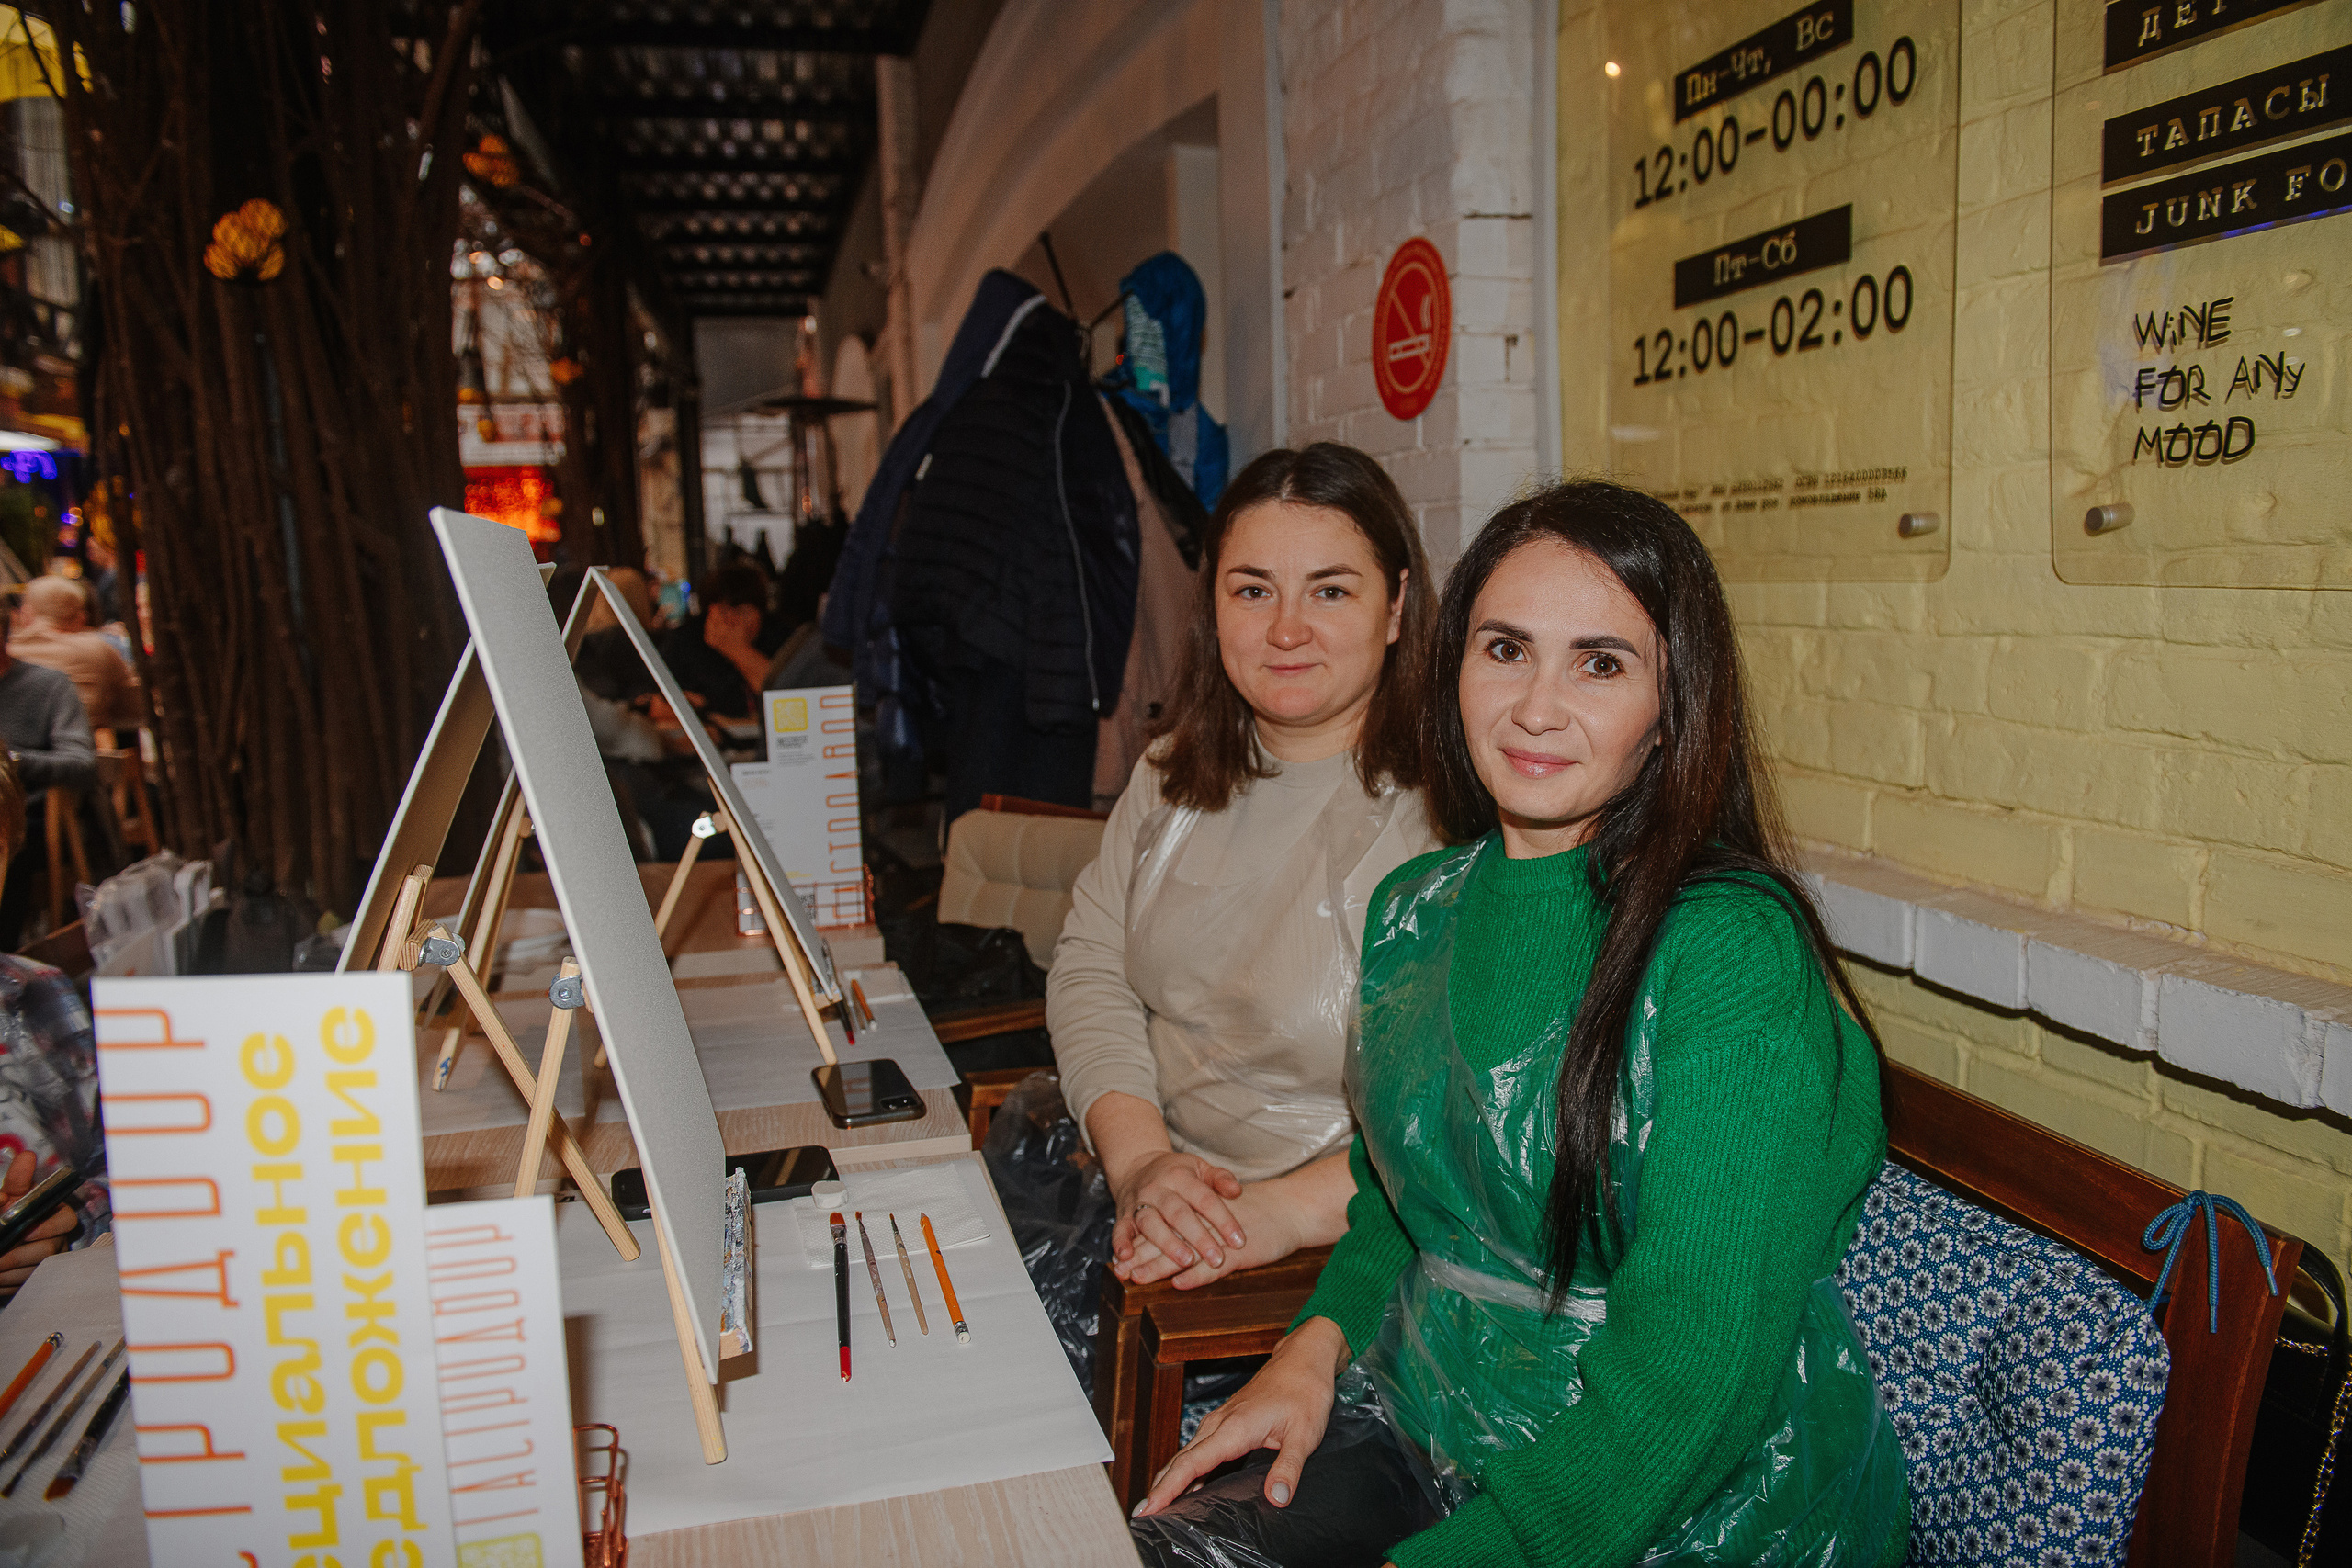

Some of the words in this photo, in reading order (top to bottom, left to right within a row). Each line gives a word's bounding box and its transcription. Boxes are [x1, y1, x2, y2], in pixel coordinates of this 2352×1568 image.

[1634, 36, 1917, 209] 12:00-00:00
[2136, 73, 2330, 158] ТАПАСЫ
[2135, 178, 2259, 236] JUNK
[2284, 157, 2348, 203] FO
[1714, 230, 1798, 288] Пт-Сб
[1633, 265, 1914, 386] 12:00-02:00
[2135, 364, 2211, 409] FOR
[2134, 415, 2256, 462] MOOD
